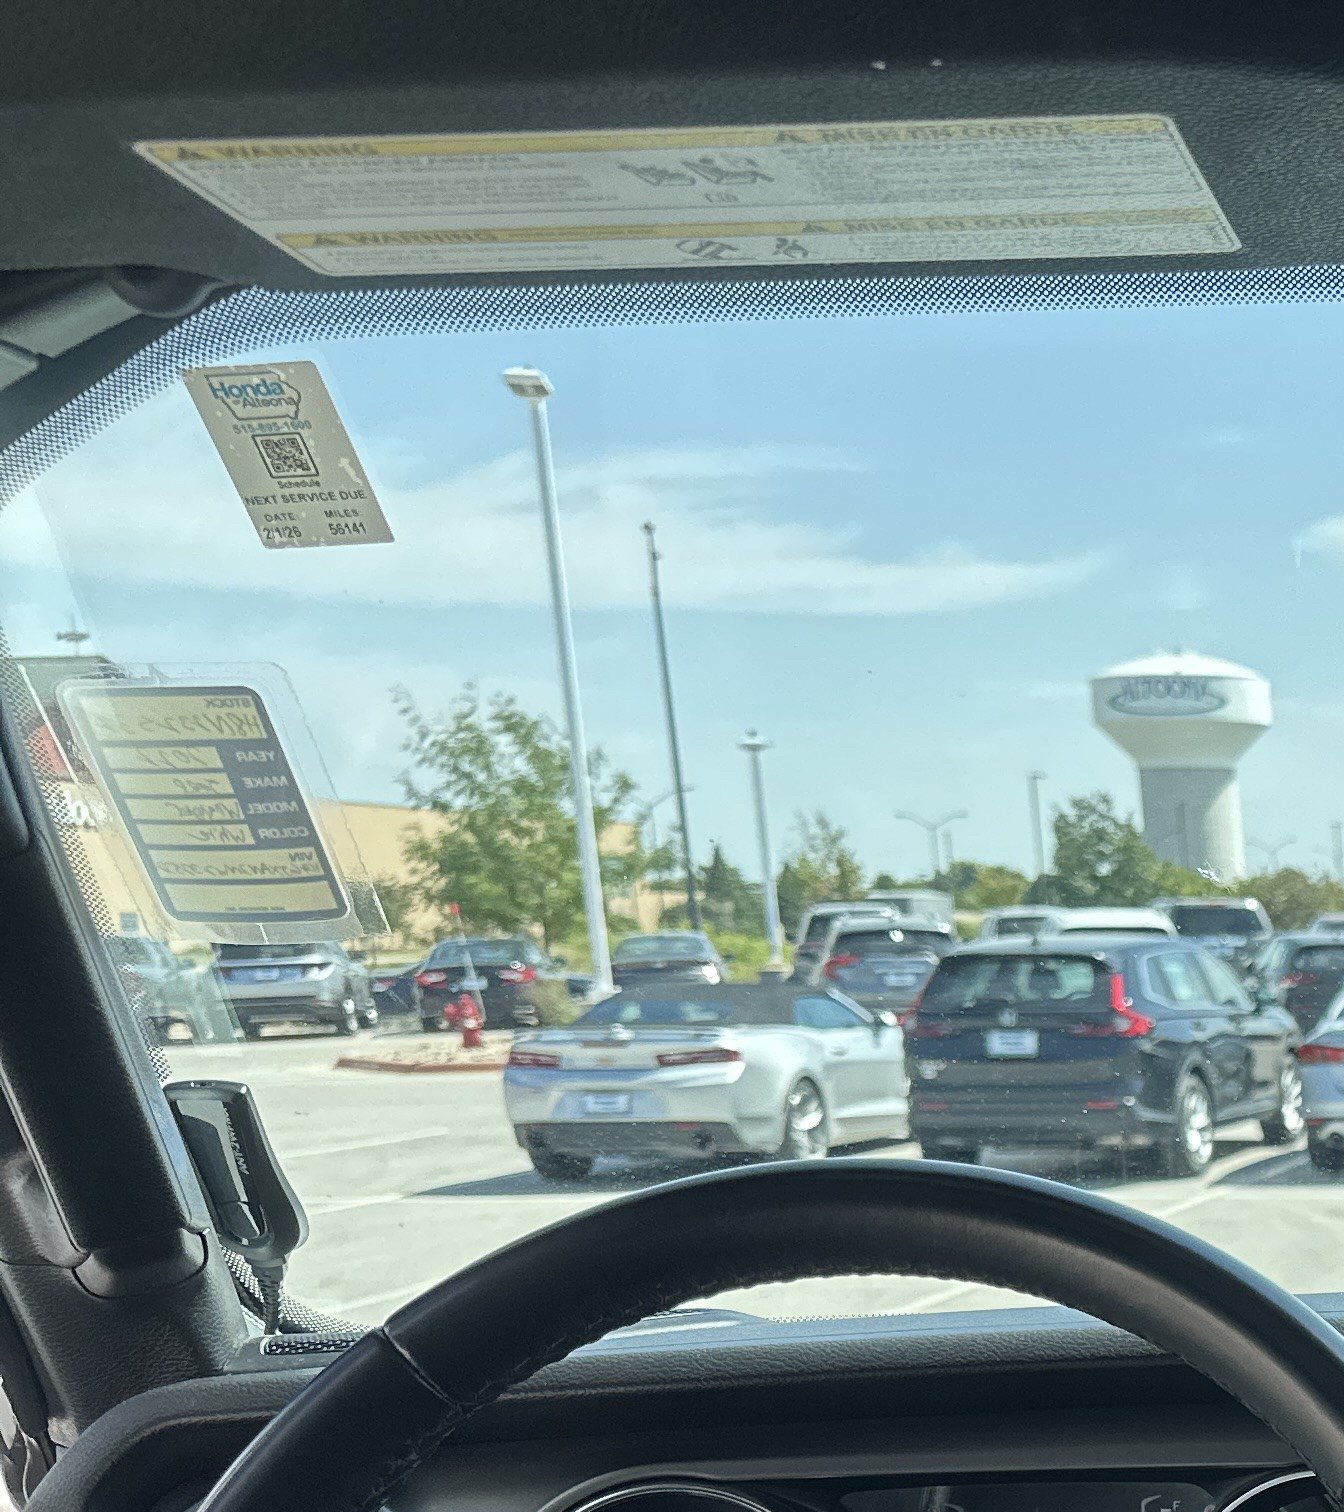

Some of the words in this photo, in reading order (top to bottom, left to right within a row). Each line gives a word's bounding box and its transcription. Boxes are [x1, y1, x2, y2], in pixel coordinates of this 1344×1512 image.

[220, 142, 379, 159] WARNING
[213, 378, 285, 400] Honda
[277, 479, 322, 490] Schedule
[245, 494, 279, 506] NEXT
[281, 490, 338, 504] SERVICE
[339, 489, 368, 501] DUE
[263, 512, 297, 523] DATE
[324, 508, 360, 519] MILES
[1172, 1500, 1181, 1511] F
